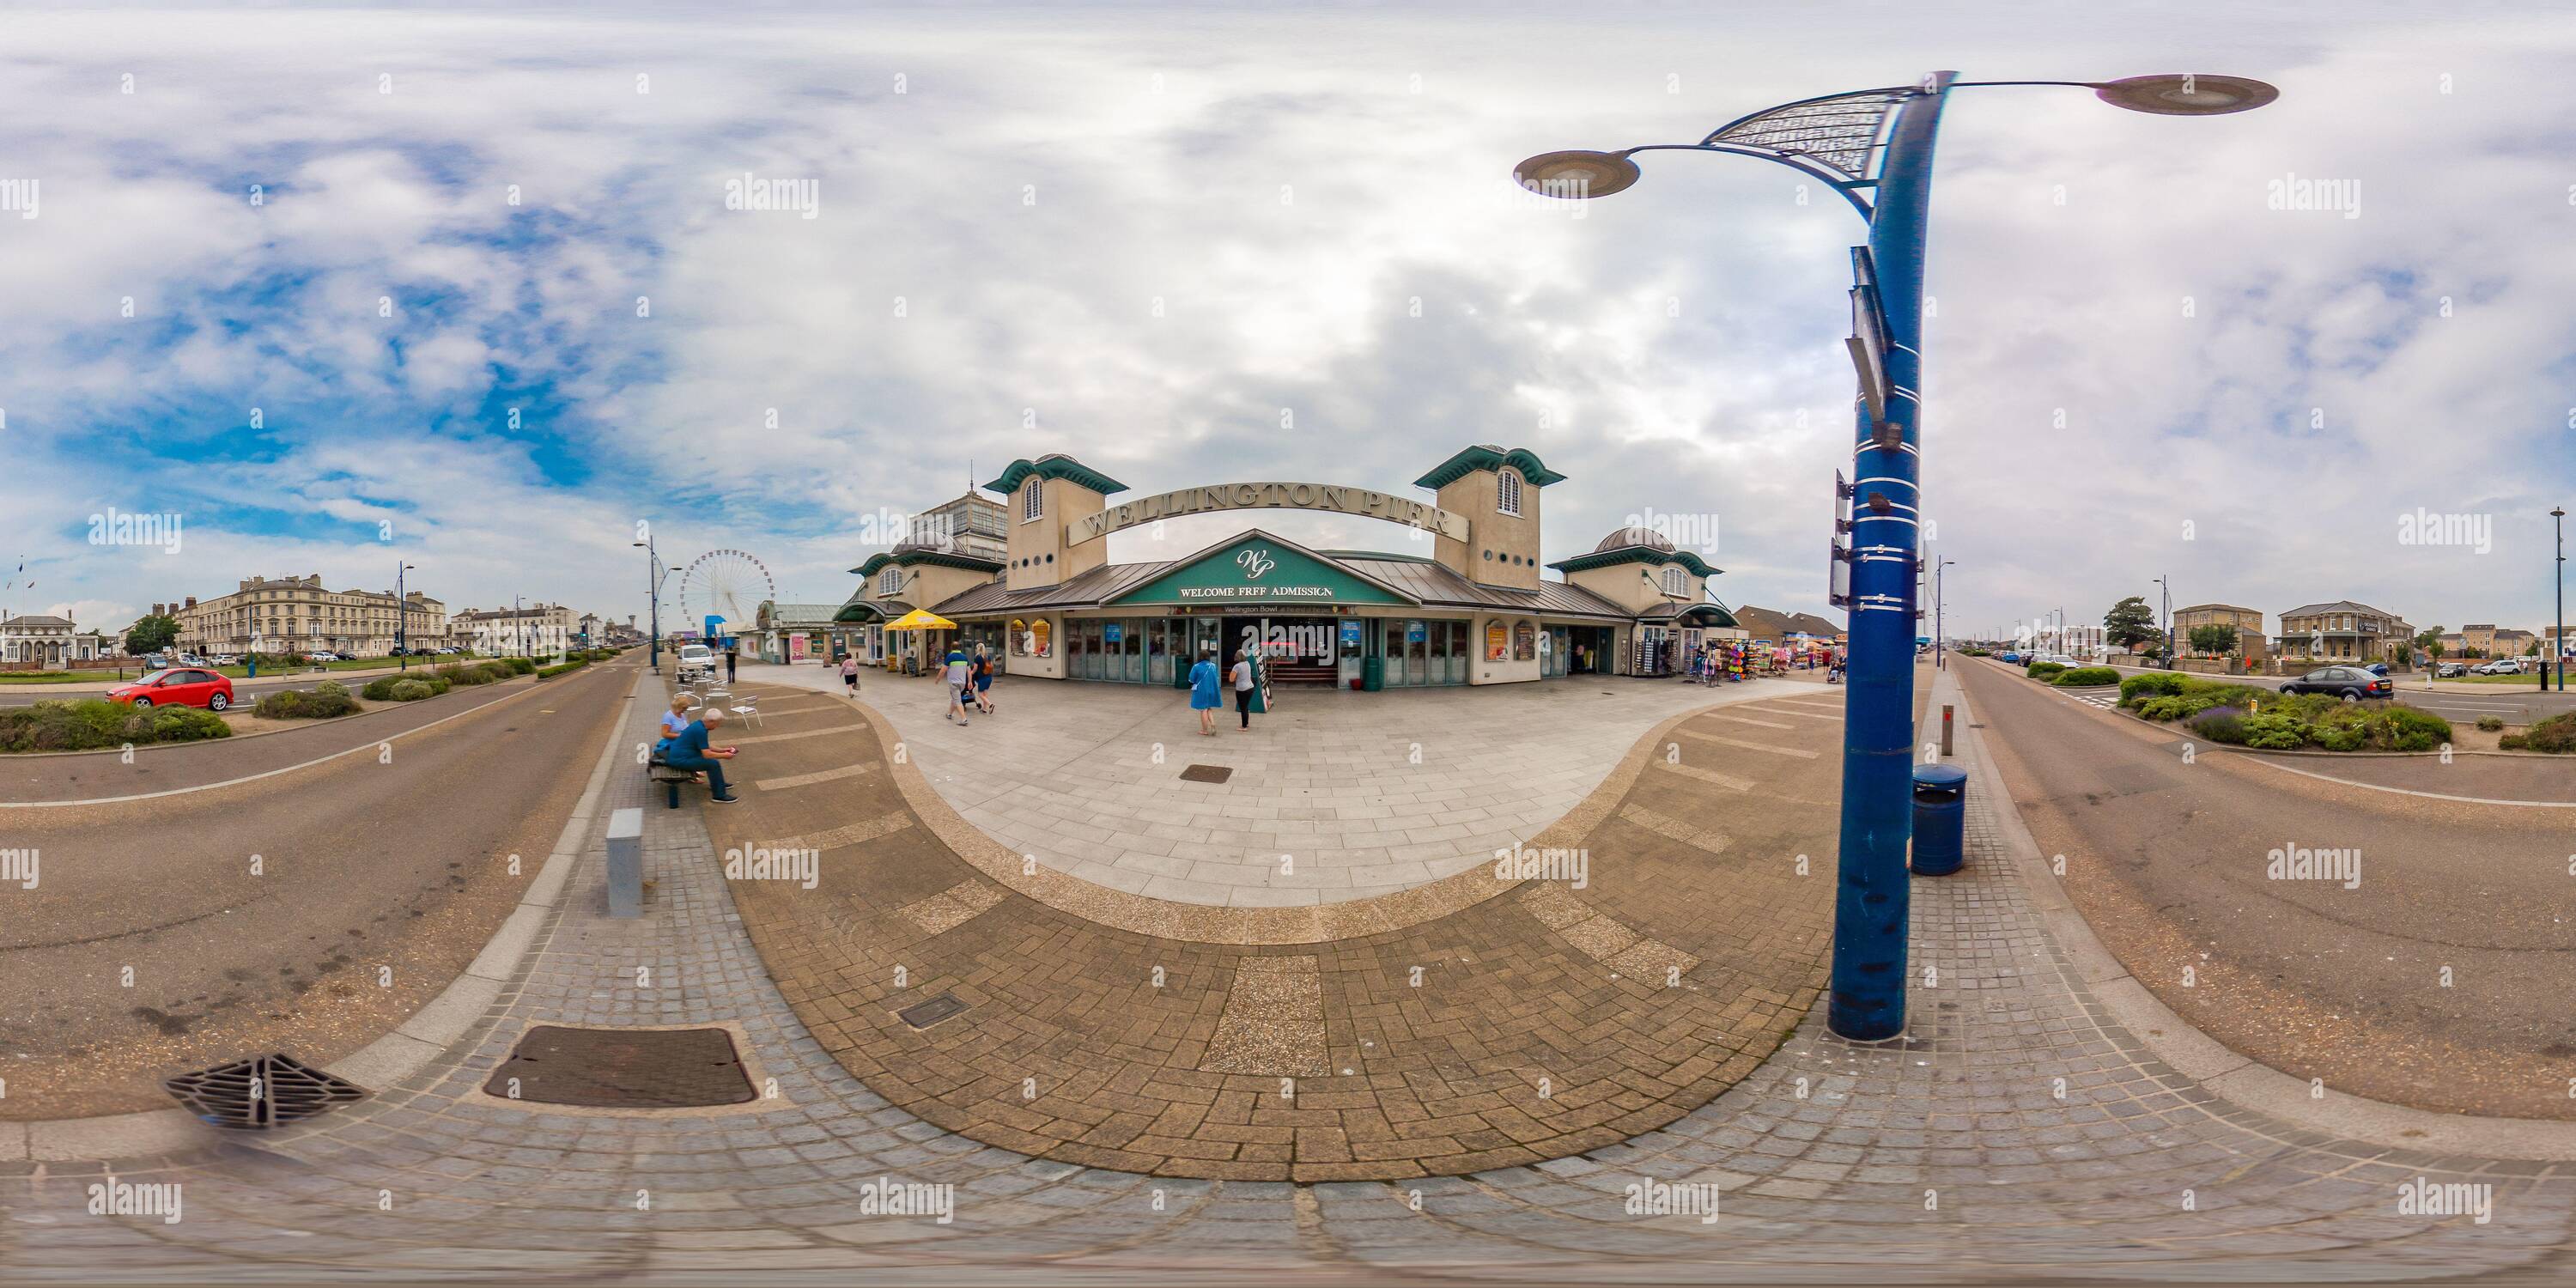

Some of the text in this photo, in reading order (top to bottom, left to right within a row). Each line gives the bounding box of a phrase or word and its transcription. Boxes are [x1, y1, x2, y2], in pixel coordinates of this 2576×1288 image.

[1083, 483, 1450, 534] WELLINGTON PIER
[1181, 587, 1235, 598] WELCOME
[1271, 586, 1333, 597] ADMISSION
